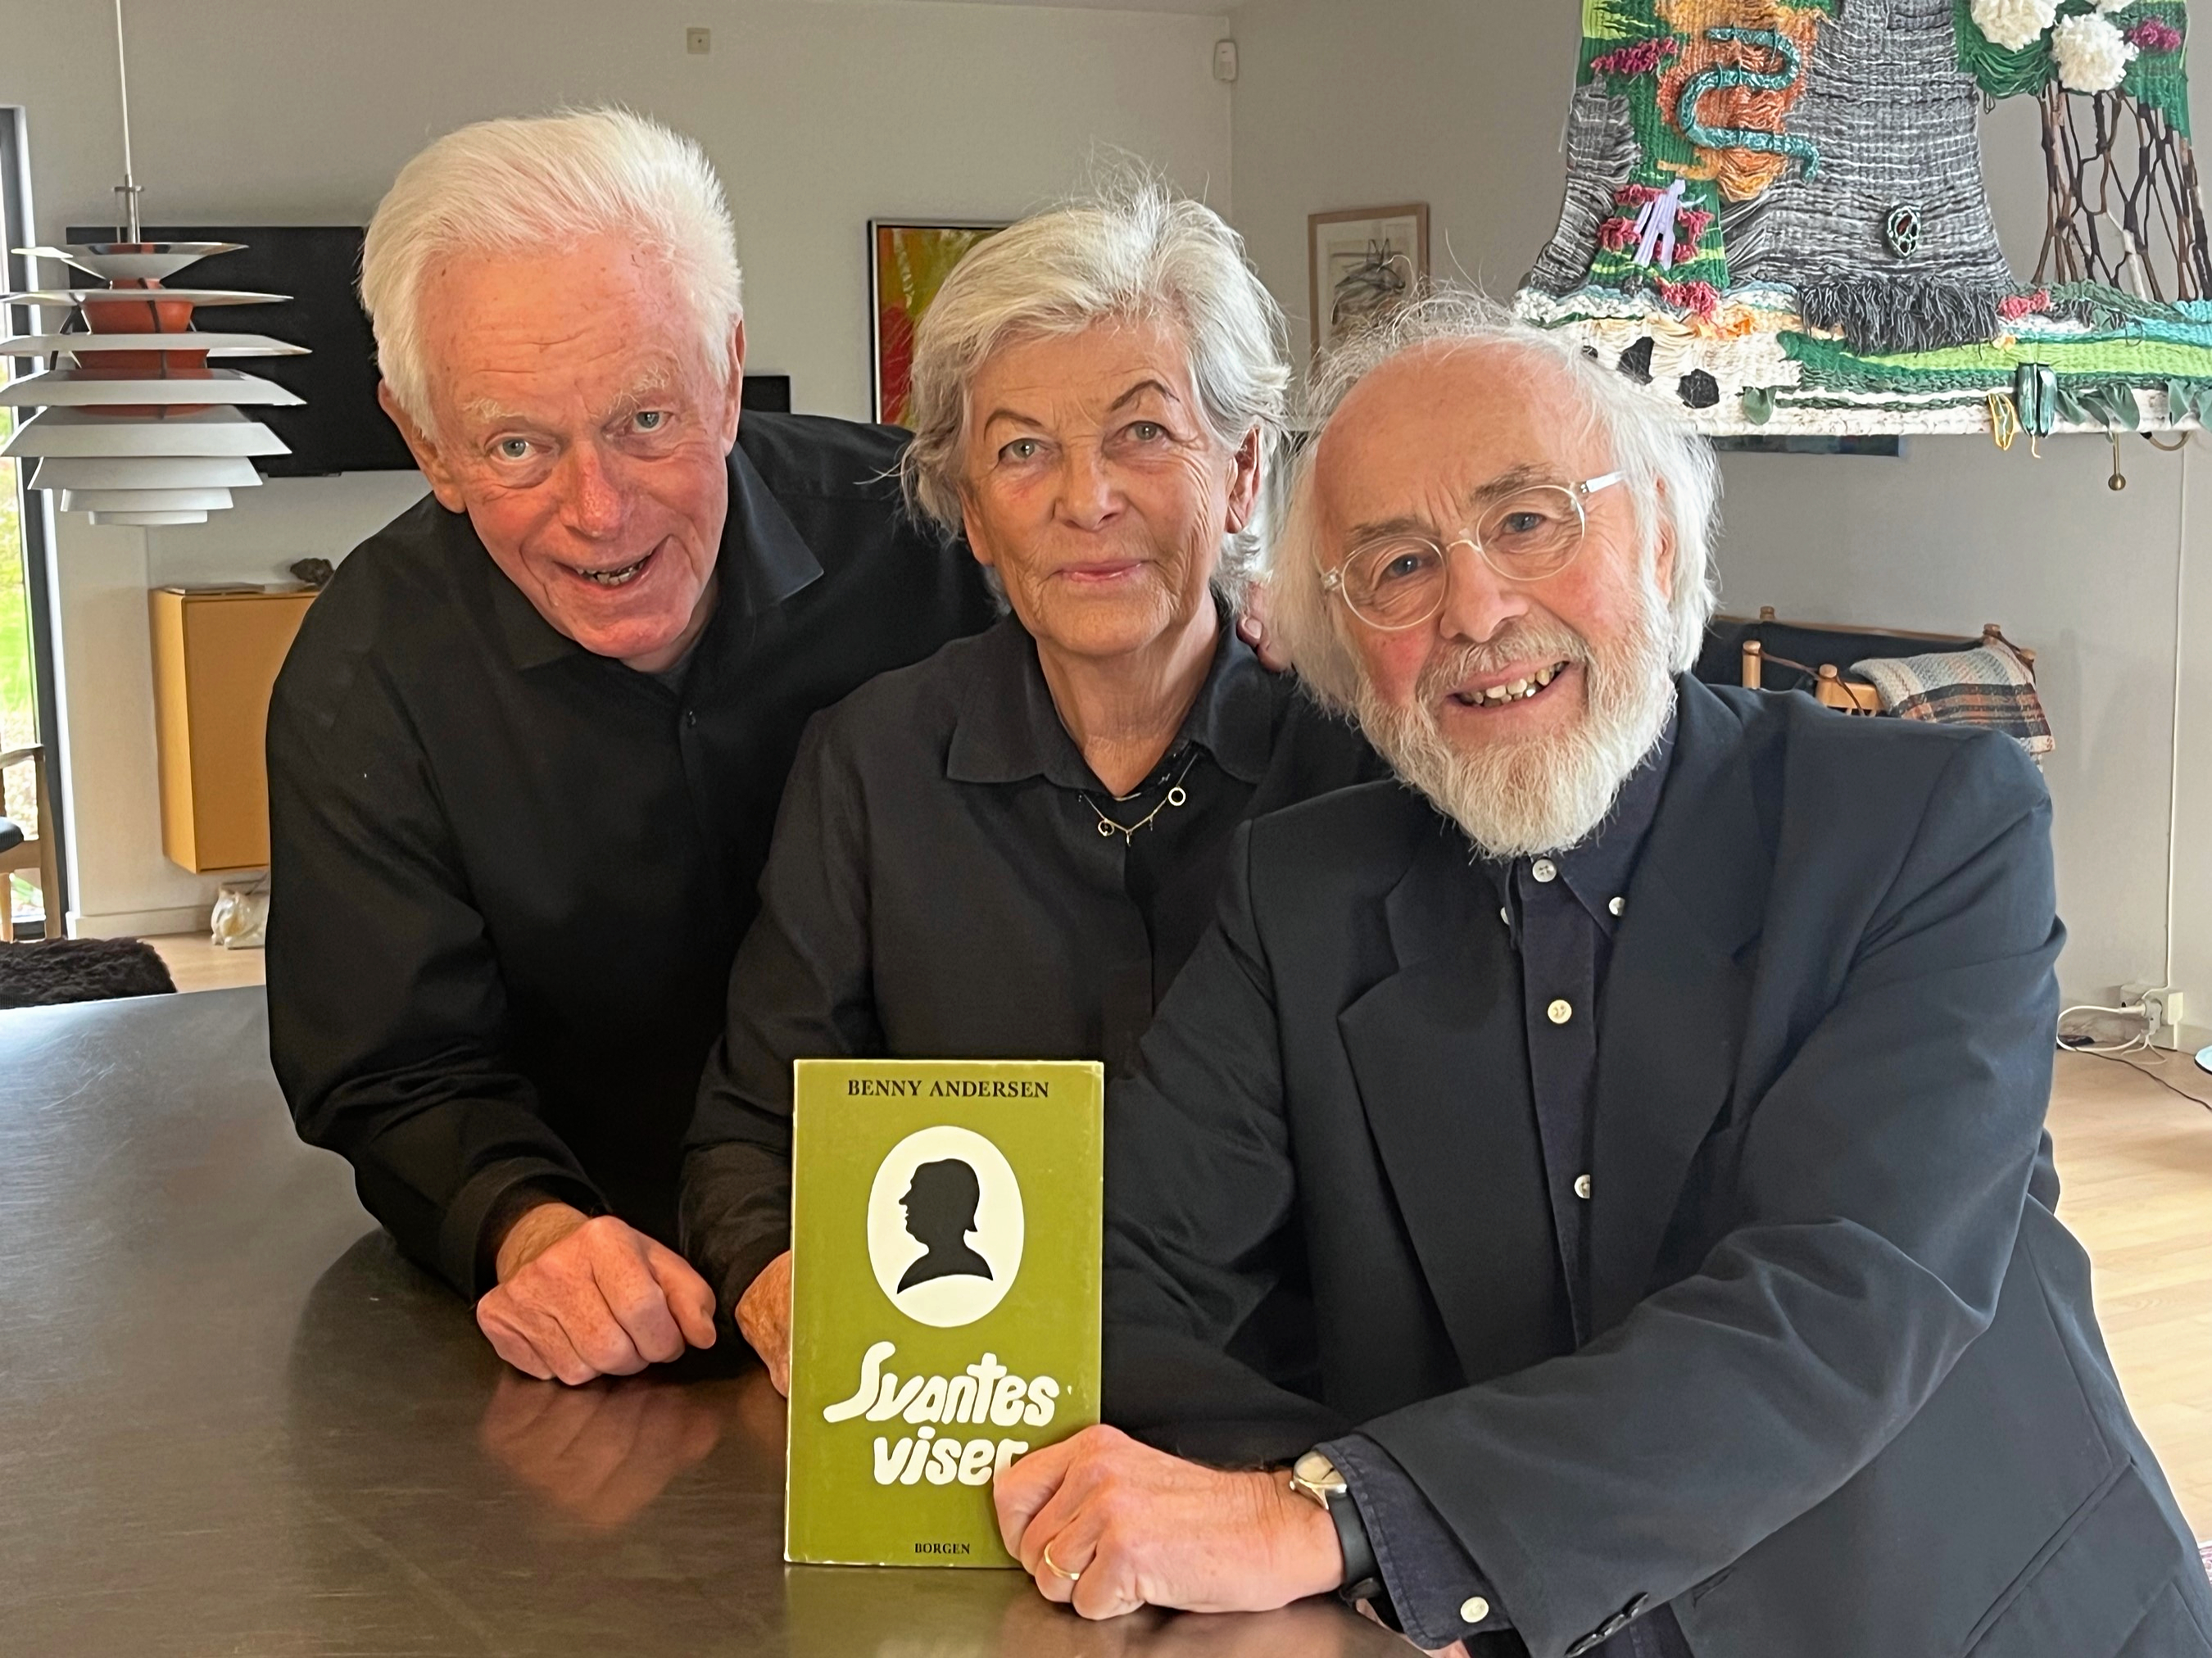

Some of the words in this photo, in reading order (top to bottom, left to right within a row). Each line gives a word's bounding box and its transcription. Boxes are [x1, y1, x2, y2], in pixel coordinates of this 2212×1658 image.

[847, 1079, 922, 1098] BENNY
[929, 1080, 1050, 1099] ANDERSEN
[823, 1340, 1060, 1427] Svantes
[873, 1425, 1029, 1486] viser
[913, 1542, 971, 1556] BORGEN
